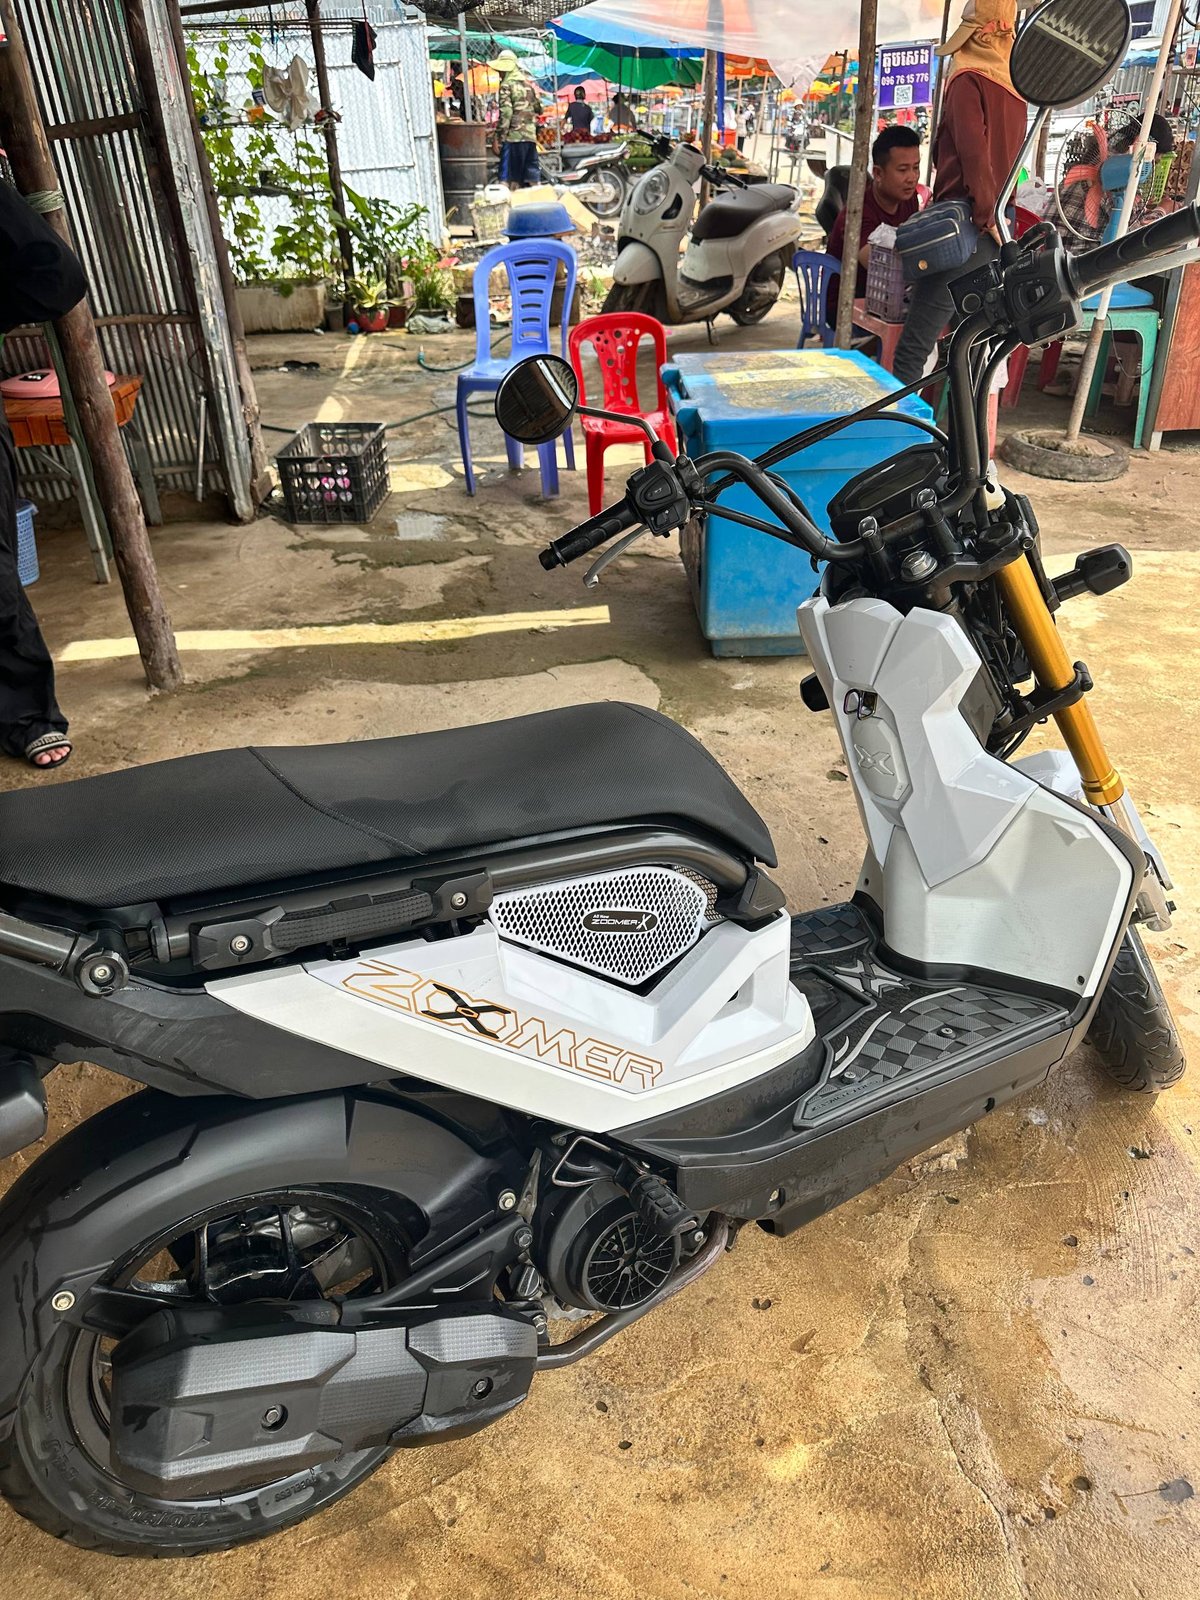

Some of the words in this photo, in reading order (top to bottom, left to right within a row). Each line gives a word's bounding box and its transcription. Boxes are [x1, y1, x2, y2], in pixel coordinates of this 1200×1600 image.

[881, 76, 895, 86] 096
[896, 75, 905, 85] 76
[906, 74, 915, 84] 15
[916, 72, 929, 83] 776
